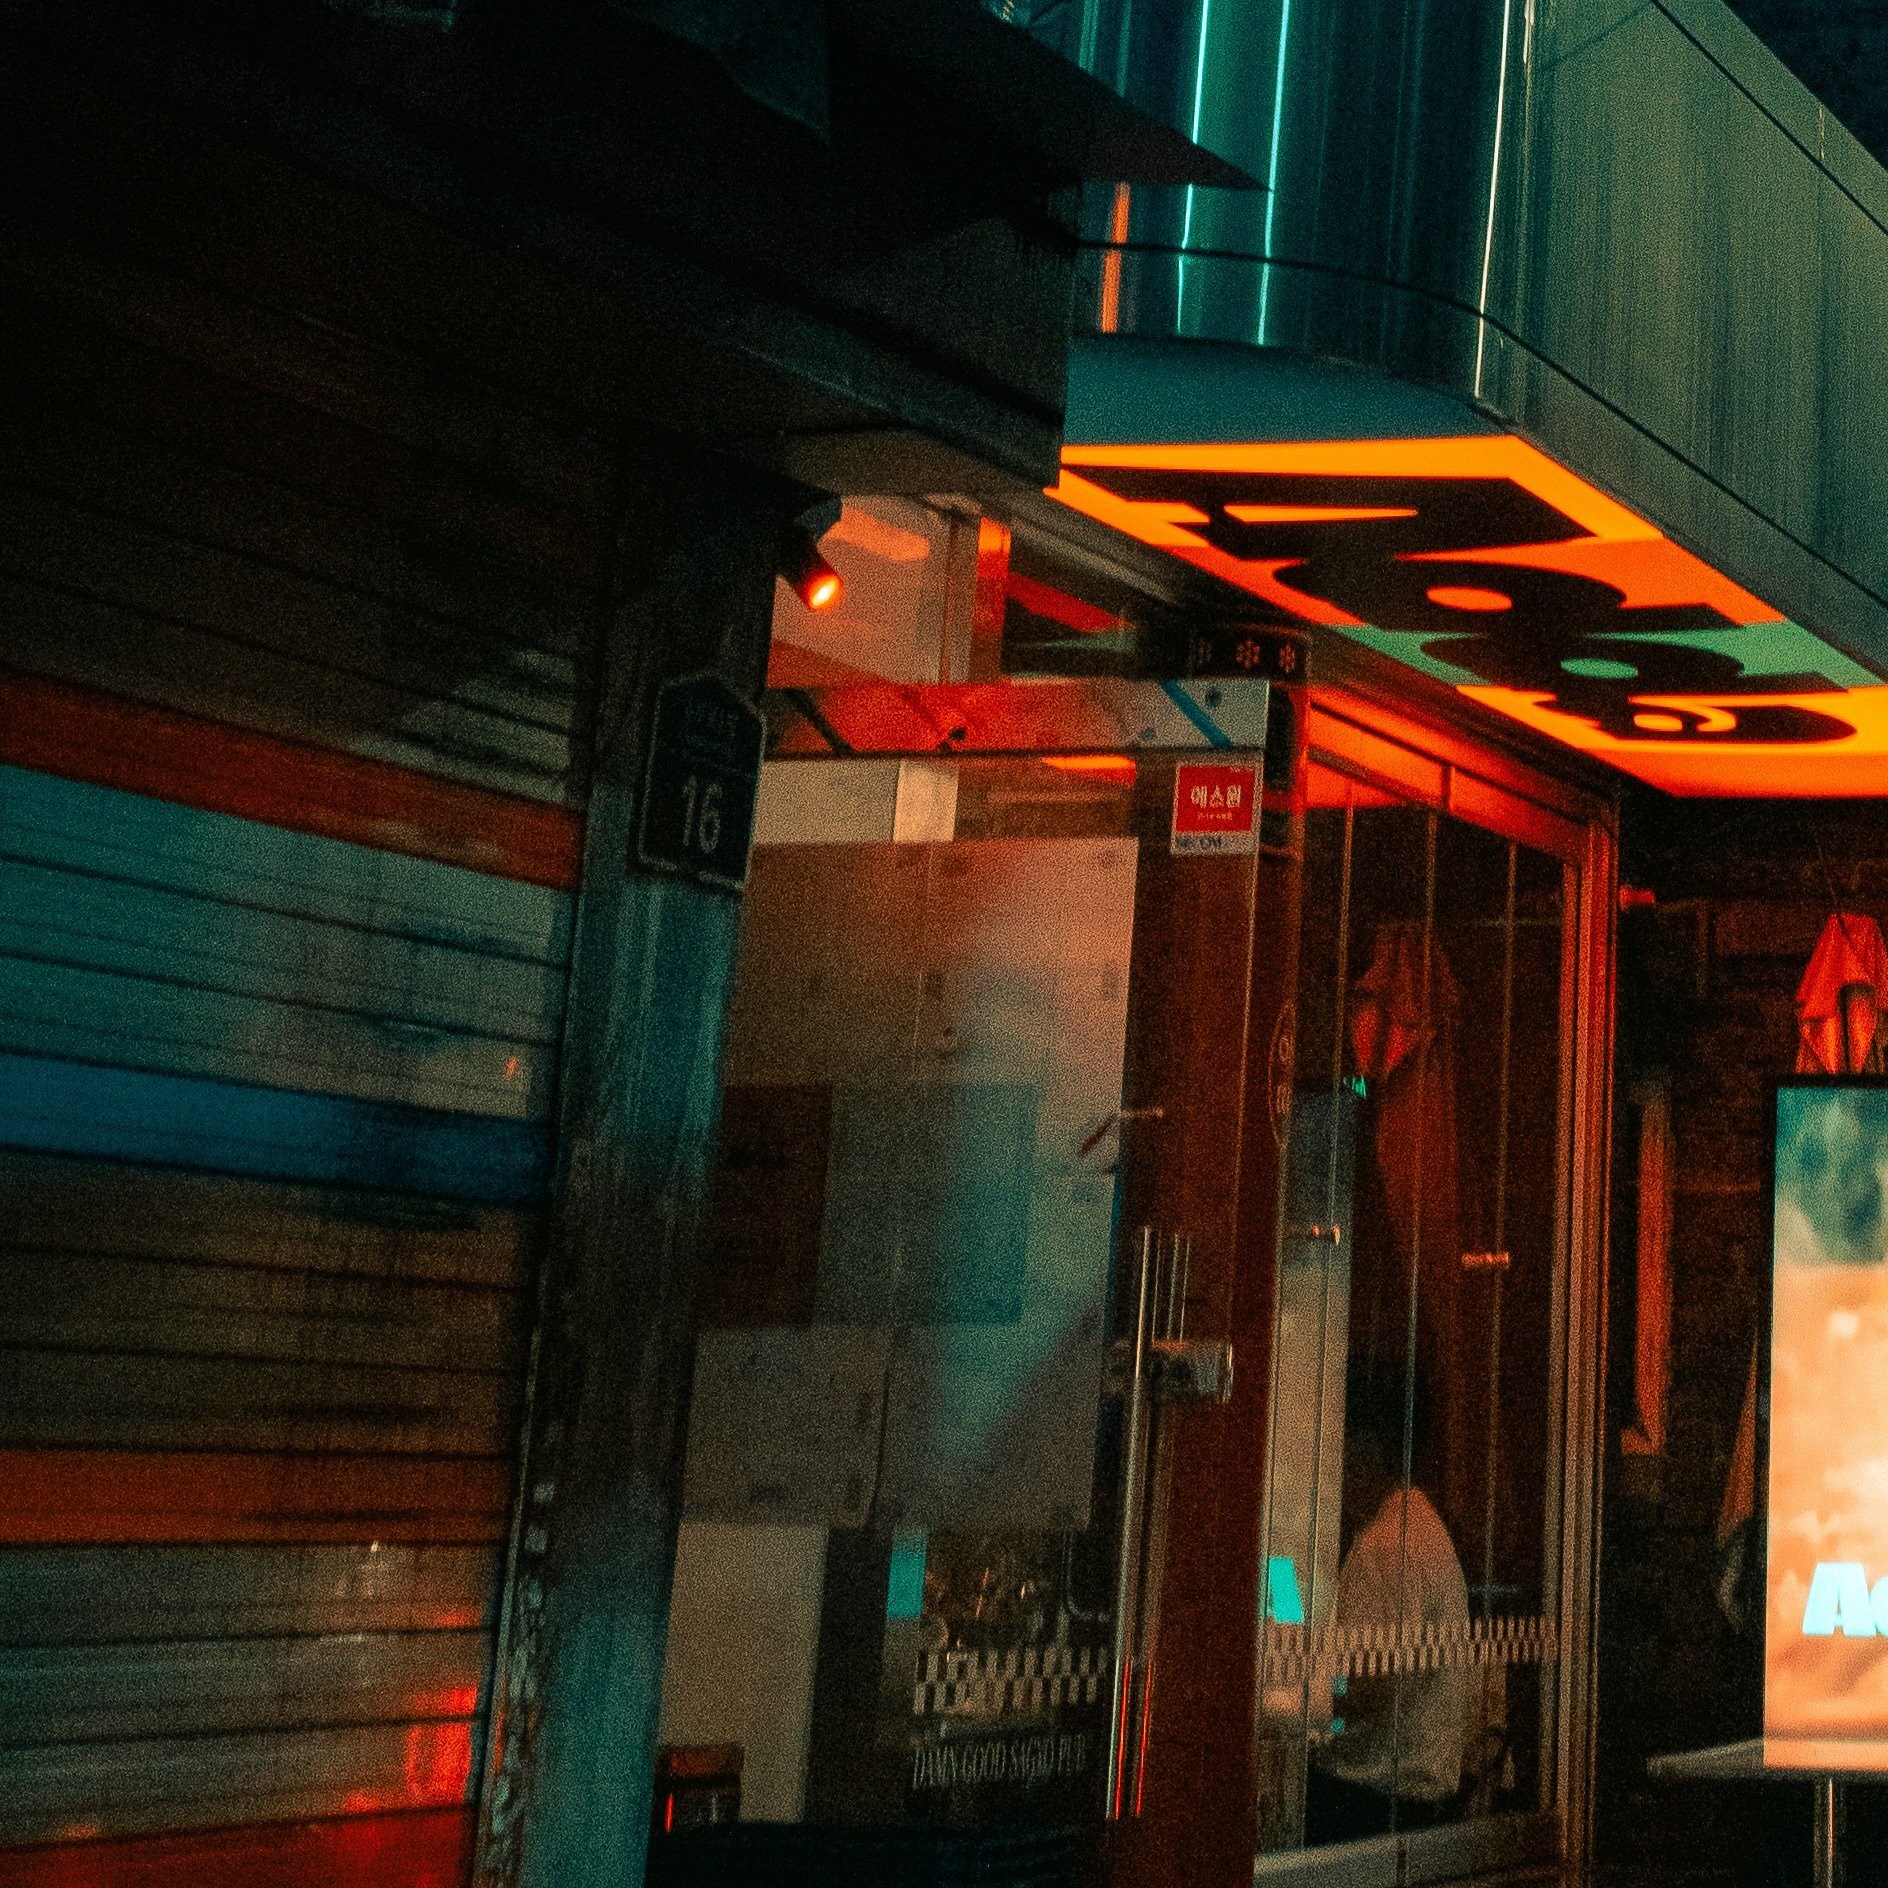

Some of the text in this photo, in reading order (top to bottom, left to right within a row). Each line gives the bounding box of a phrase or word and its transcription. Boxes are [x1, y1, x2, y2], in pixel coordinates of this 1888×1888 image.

[1062, 464, 1860, 747] Adda
[681, 773, 724, 856] 16
[1189, 784, 1243, 810] 에스원
